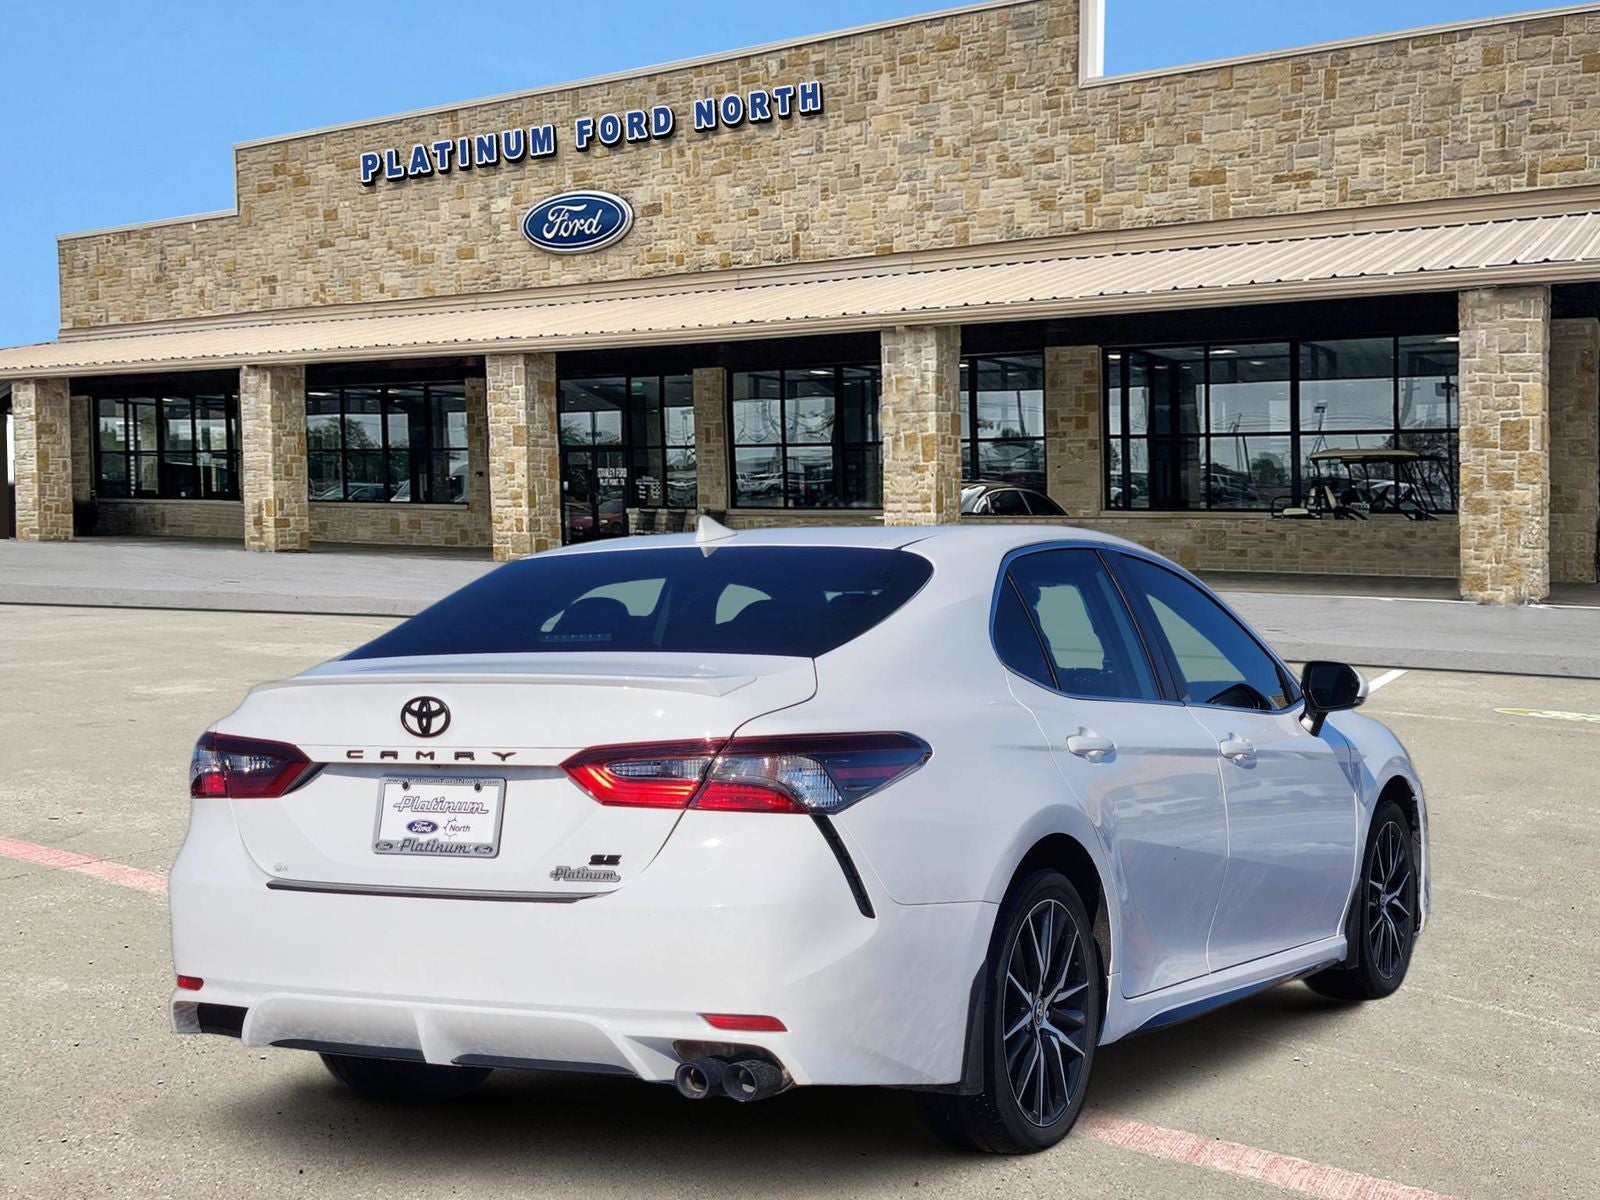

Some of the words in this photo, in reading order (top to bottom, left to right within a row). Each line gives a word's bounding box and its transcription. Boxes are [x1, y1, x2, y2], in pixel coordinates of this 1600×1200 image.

[360, 124, 556, 186] PLATINUM
[576, 104, 674, 153] FORD
[694, 81, 823, 132] NORTH
[542, 203, 603, 240] Ford
[346, 749, 517, 763] CAMRY
[393, 795, 490, 815] Platinum
[410, 821, 434, 833] Ford
[449, 824, 471, 833] North
[398, 836, 471, 854] Platinum
[588, 854, 622, 866] SE
[549, 865, 622, 883] Platinum
